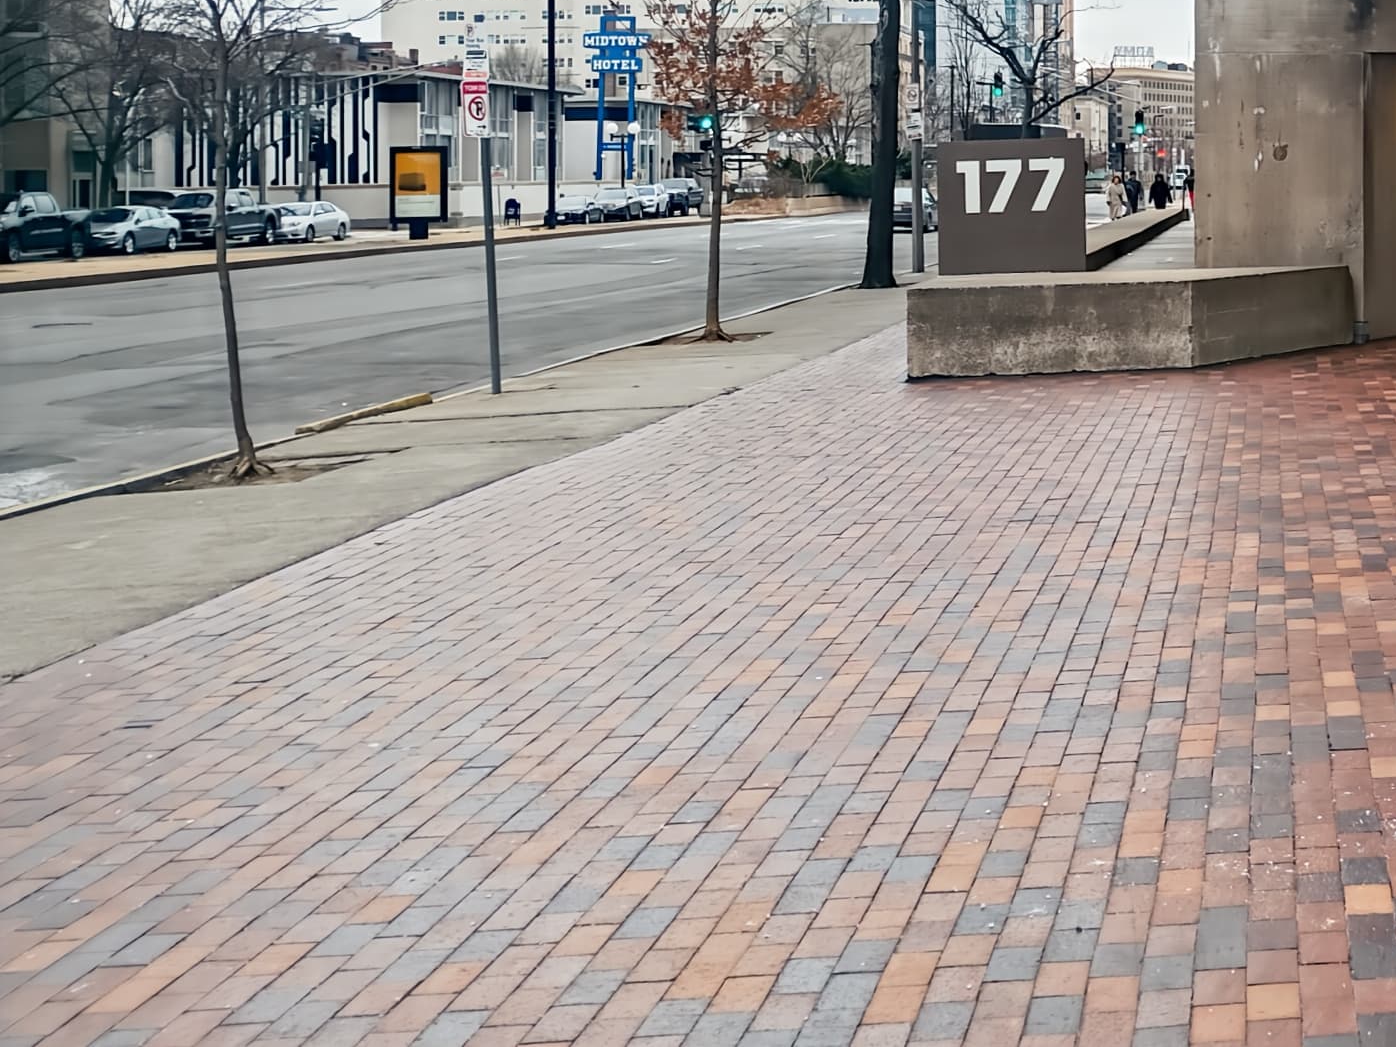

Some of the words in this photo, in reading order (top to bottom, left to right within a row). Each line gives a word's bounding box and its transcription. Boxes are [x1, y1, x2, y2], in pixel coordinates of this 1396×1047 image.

[584, 35, 649, 47] MIDTOWN
[593, 59, 639, 71] HOTEL
[956, 157, 1065, 214] 177
